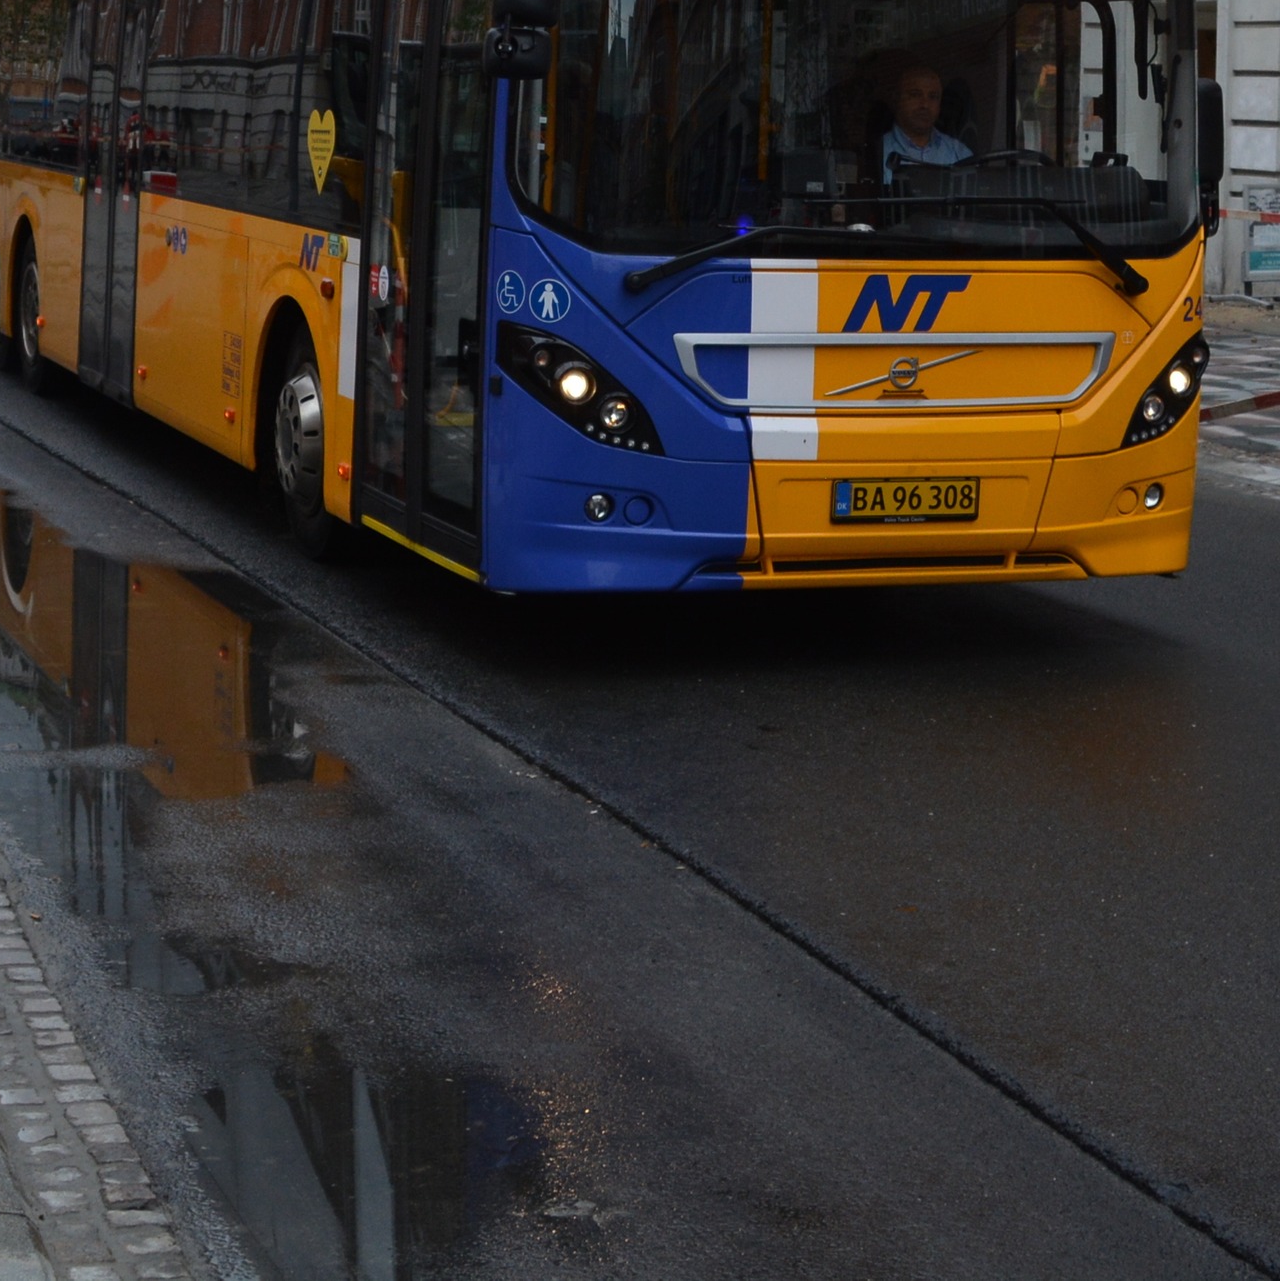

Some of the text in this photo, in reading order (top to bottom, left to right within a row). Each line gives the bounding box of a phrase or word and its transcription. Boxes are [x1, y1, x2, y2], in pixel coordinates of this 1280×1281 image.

[298, 232, 325, 272] NT
[841, 274, 973, 333] NT
[837, 502, 847, 510] DK
[852, 484, 974, 512] BA 96 308
